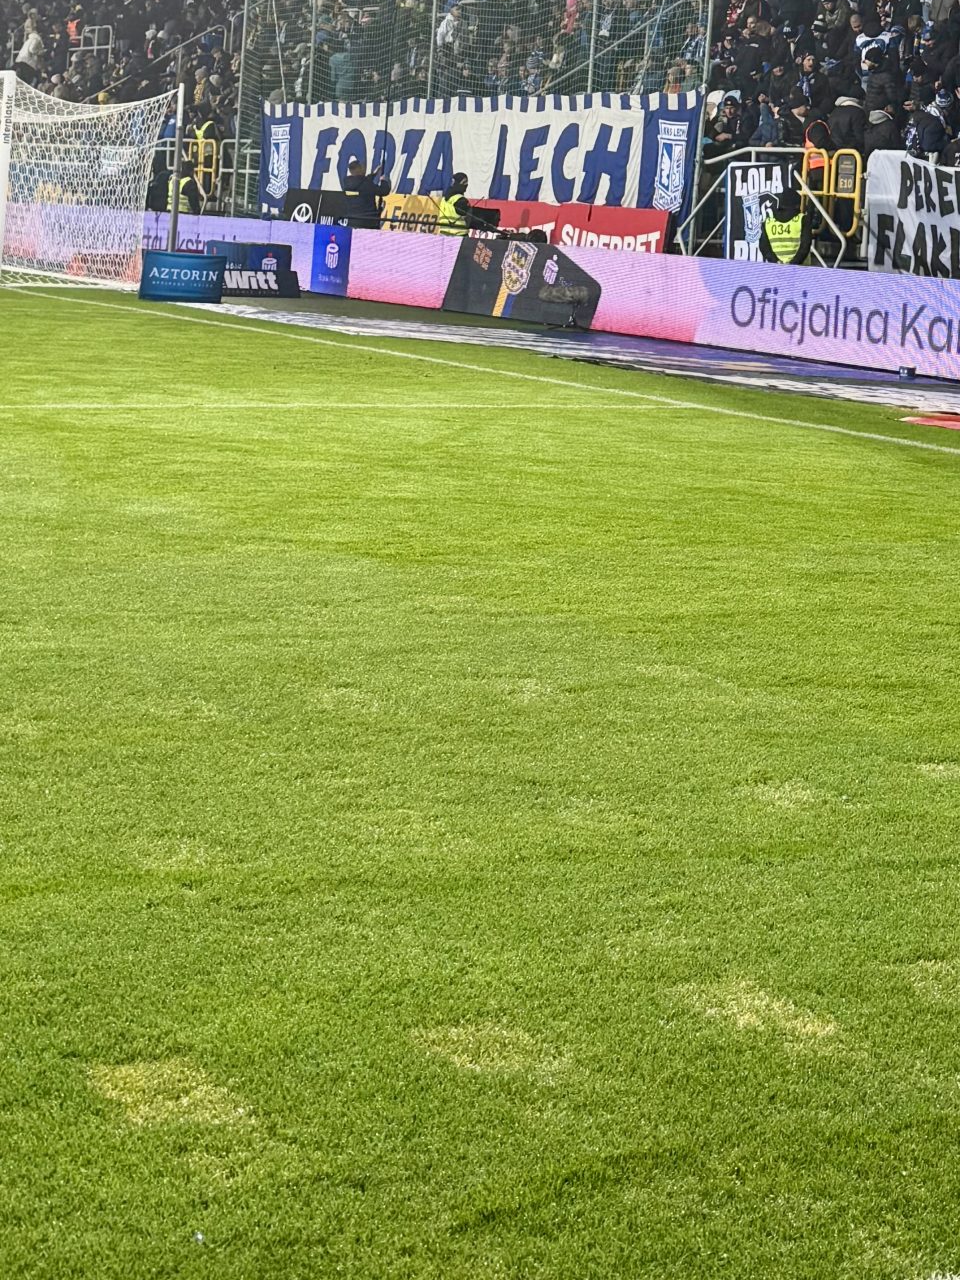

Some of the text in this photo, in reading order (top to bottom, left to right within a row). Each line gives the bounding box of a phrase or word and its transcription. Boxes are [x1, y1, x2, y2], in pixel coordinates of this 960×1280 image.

[3, 94, 14, 144] Interplastic
[308, 122, 634, 206] FORZA LECH
[735, 165, 784, 197] LOLA
[839, 179, 853, 189] E10
[771, 224, 791, 236] 034
[149, 266, 219, 281] AZTORIN
[222, 270, 279, 290] Witt
[730, 285, 889, 346] Oficjalna
